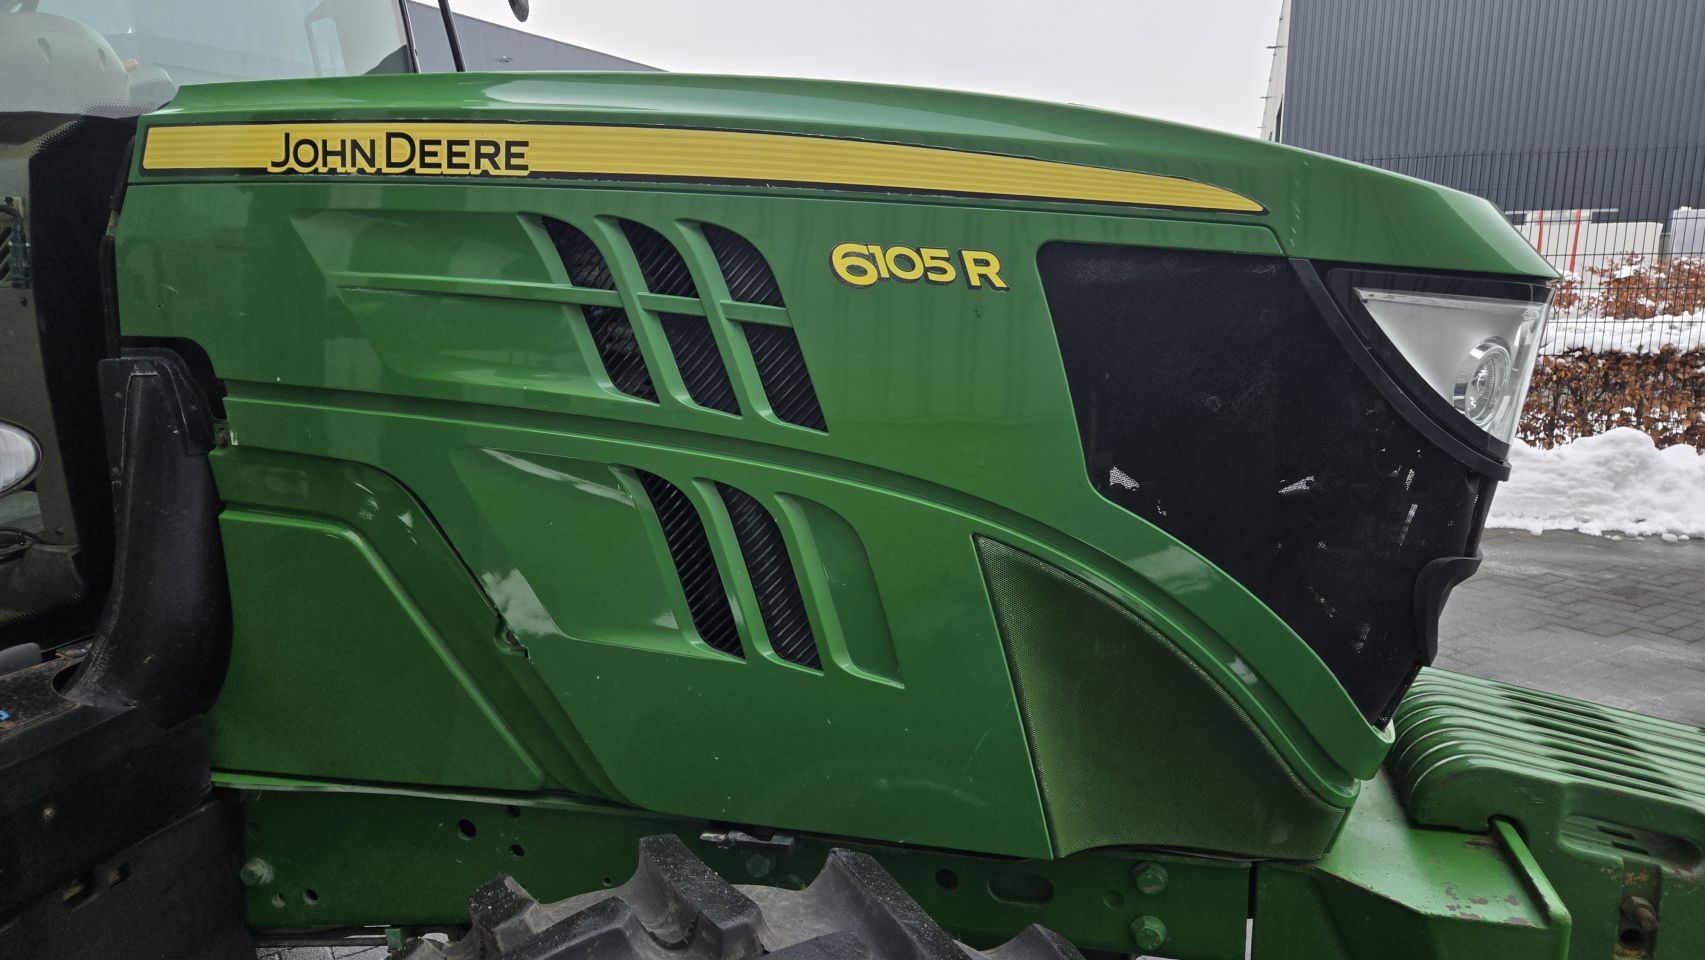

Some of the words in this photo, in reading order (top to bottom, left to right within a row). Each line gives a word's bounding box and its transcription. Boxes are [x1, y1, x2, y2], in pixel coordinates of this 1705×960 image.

[270, 131, 376, 169] JOHN
[385, 131, 529, 171] DEERE
[830, 243, 957, 287] 6105
[960, 249, 1009, 290] R
